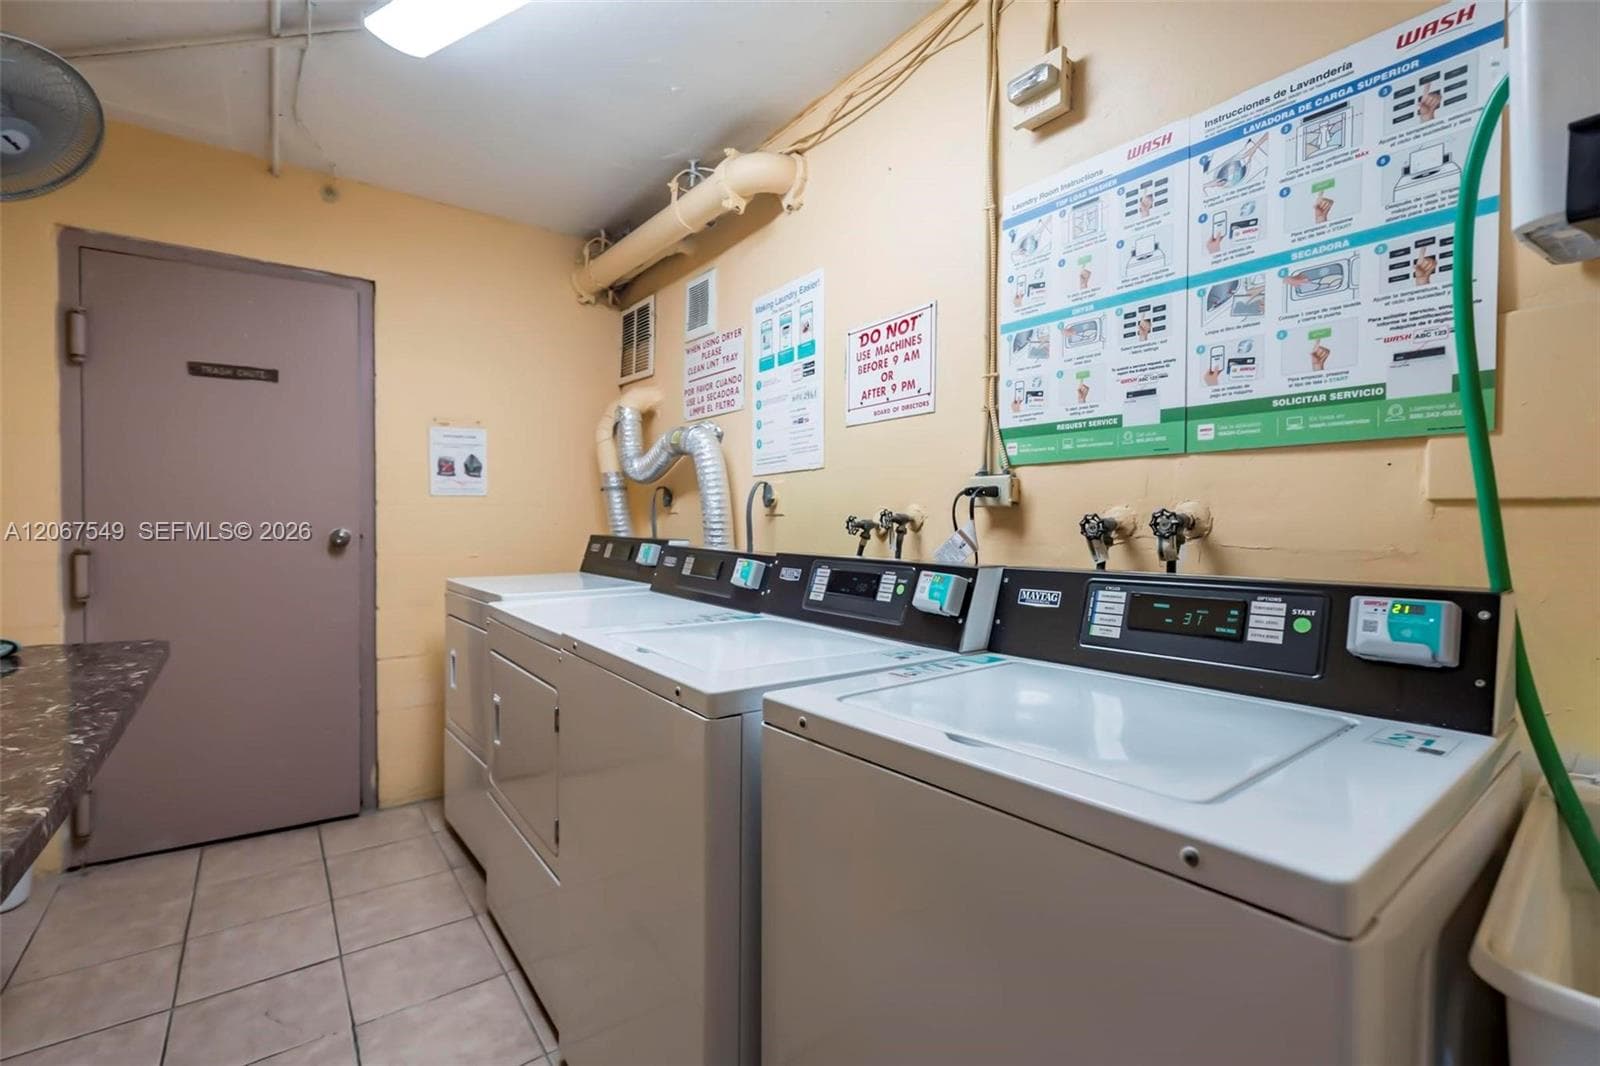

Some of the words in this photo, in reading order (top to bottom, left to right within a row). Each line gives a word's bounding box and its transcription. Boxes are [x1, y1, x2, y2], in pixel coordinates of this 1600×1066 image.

[1396, 3, 1476, 49] WASH
[1204, 95, 1271, 128] Instrucciones
[1273, 88, 1287, 100] de
[1290, 61, 1353, 93] Lavandería
[1243, 110, 1296, 135] LAVADORA
[1298, 102, 1313, 113] DE
[1315, 87, 1355, 106] CARGA
[1357, 59, 1420, 89] SUPERIOR
[1127, 132, 1173, 161] WASH
[1012, 196, 1038, 211] Laundry
[1039, 187, 1059, 199] Room
[1060, 168, 1104, 190] Instructions
[1291, 239, 1350, 261] SECADORA
[686, 344, 701, 354] WHEN
[702, 335, 720, 350] USING
[721, 327, 742, 342] DRYER
[859, 329, 881, 348] DO
[886, 315, 919, 340] NOT
[1383, 333, 1412, 343] WASH
[1414, 331, 1432, 340] ABC
[1434, 329, 1448, 337] 123
[701, 345, 722, 360] PLEASE
[856, 349, 871, 362] USE
[875, 333, 922, 357] MACHINES
[201, 365, 234, 375] TRASH
[236, 368, 266, 379] CHUTE
[687, 363, 705, 376] CLEAN
[706, 358, 719, 370] LINT
[722, 352, 739, 364] TRAY
[857, 358, 889, 375] BEFORE
[892, 355, 899, 365] 9
[903, 349, 920, 363] AM
[715, 373, 742, 389] CUANDO
[880, 370, 894, 382] OR
[697, 395, 705, 405] LA
[706, 386, 740, 402] SECADORA
[861, 386, 887, 401] AFTER
[891, 383, 897, 394] 9
[901, 379, 916, 392] PM
[1272, 392, 1327, 408] SOLICITAR
[1330, 387, 1385, 401] SERVICIO
[707, 404, 713, 413] EL
[715, 398, 736, 410] FILTRO
[873, 408, 891, 417] BOARD
[901, 400, 930, 411] DIRECTORS
[1056, 421, 1087, 431] REQUEST
[1088, 417, 1118, 428] SERVICE
[1021, 590, 1058, 602] MAYTAG
[1291, 608, 1317, 617] START
[1392, 603, 1410, 614] 21
